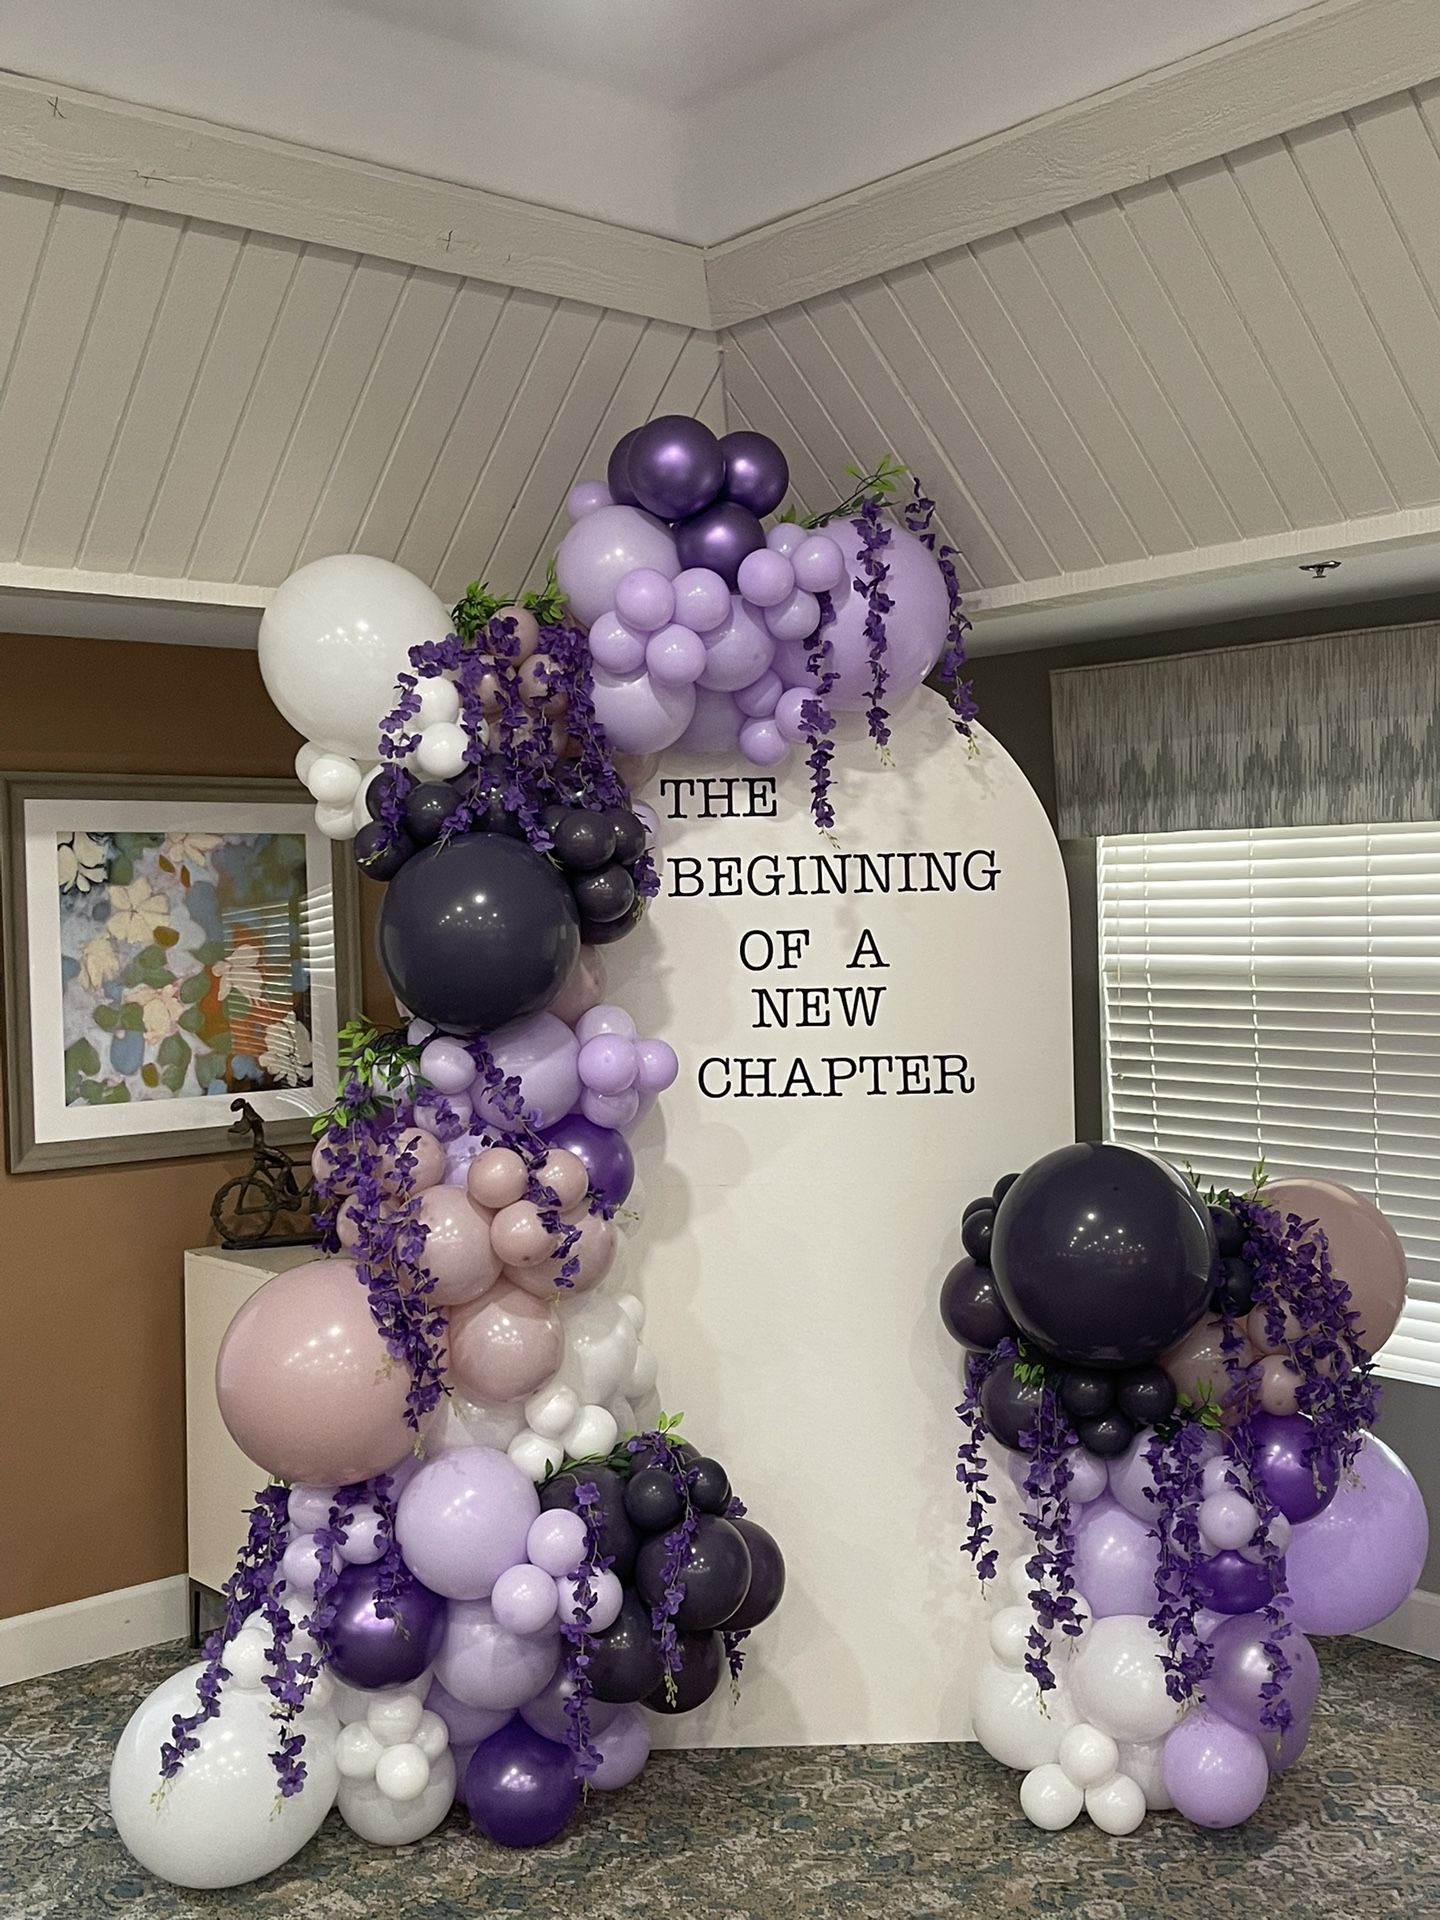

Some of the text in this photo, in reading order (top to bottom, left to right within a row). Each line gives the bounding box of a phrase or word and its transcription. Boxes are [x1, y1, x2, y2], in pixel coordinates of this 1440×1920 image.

[660, 777, 778, 818] THE
[667, 850, 1001, 897] BEGINNING
[739, 928, 891, 971] OF A
[751, 986, 887, 1028] NEW
[698, 1054, 975, 1098] CHAPTER
